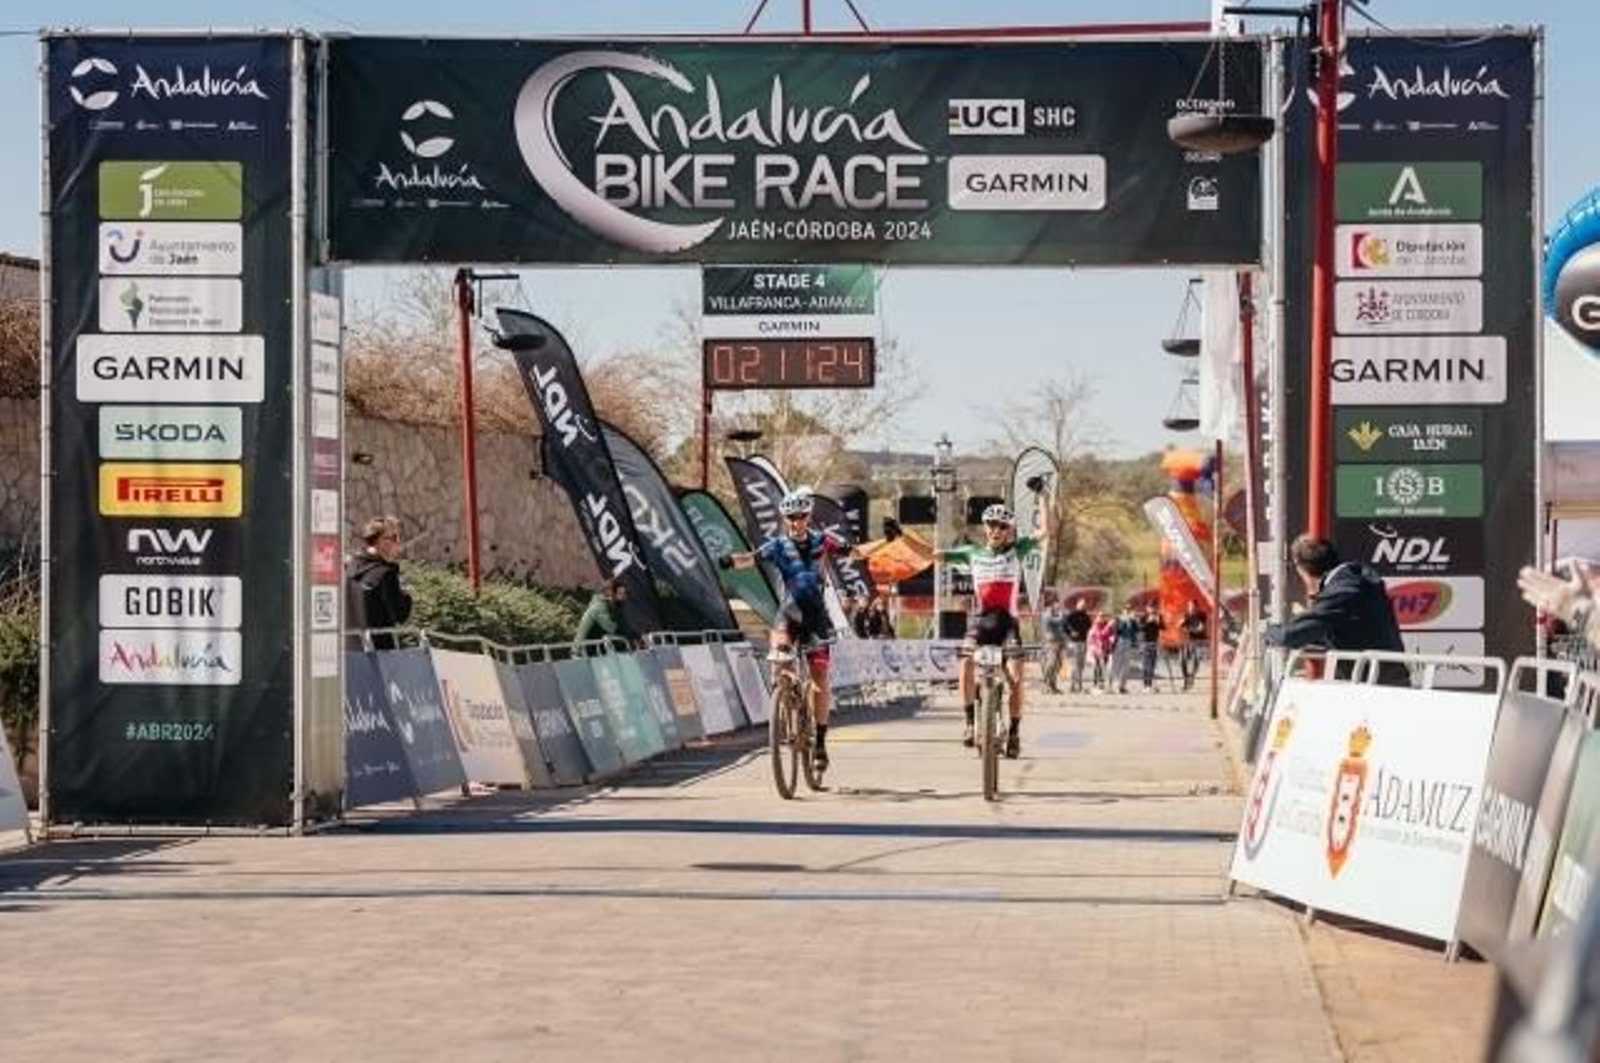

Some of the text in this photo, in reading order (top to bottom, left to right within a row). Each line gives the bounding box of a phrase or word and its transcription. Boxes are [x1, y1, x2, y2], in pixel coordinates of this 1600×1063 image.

[129, 64, 269, 100] Andalucía
[1366, 65, 1510, 100] Andalucía
[589, 70, 927, 152] Andalucía
[962, 106, 1076, 128] UCI SHC
[374, 162, 486, 190] Andalucía
[595, 153, 929, 209] BIKE RACE
[966, 173, 1089, 193] GARMIN
[884, 221, 932, 240] 2024
[753, 273, 826, 289] STAGE 4
[758, 321, 820, 332] GARMIN
[93, 356, 243, 381] GARMIN
[1329, 358, 1484, 382] GARMIN
[1388, 424, 1472, 438] CAJA RURAL
[116, 476, 224, 503] PIRELLI
[1371, 537, 1450, 563] NDL
[126, 586, 215, 618] GOBIK
[109, 639, 232, 672] Andalucía
[125, 722, 215, 741] #ABR2024
[1364, 768, 1472, 833] ADAMUZ
